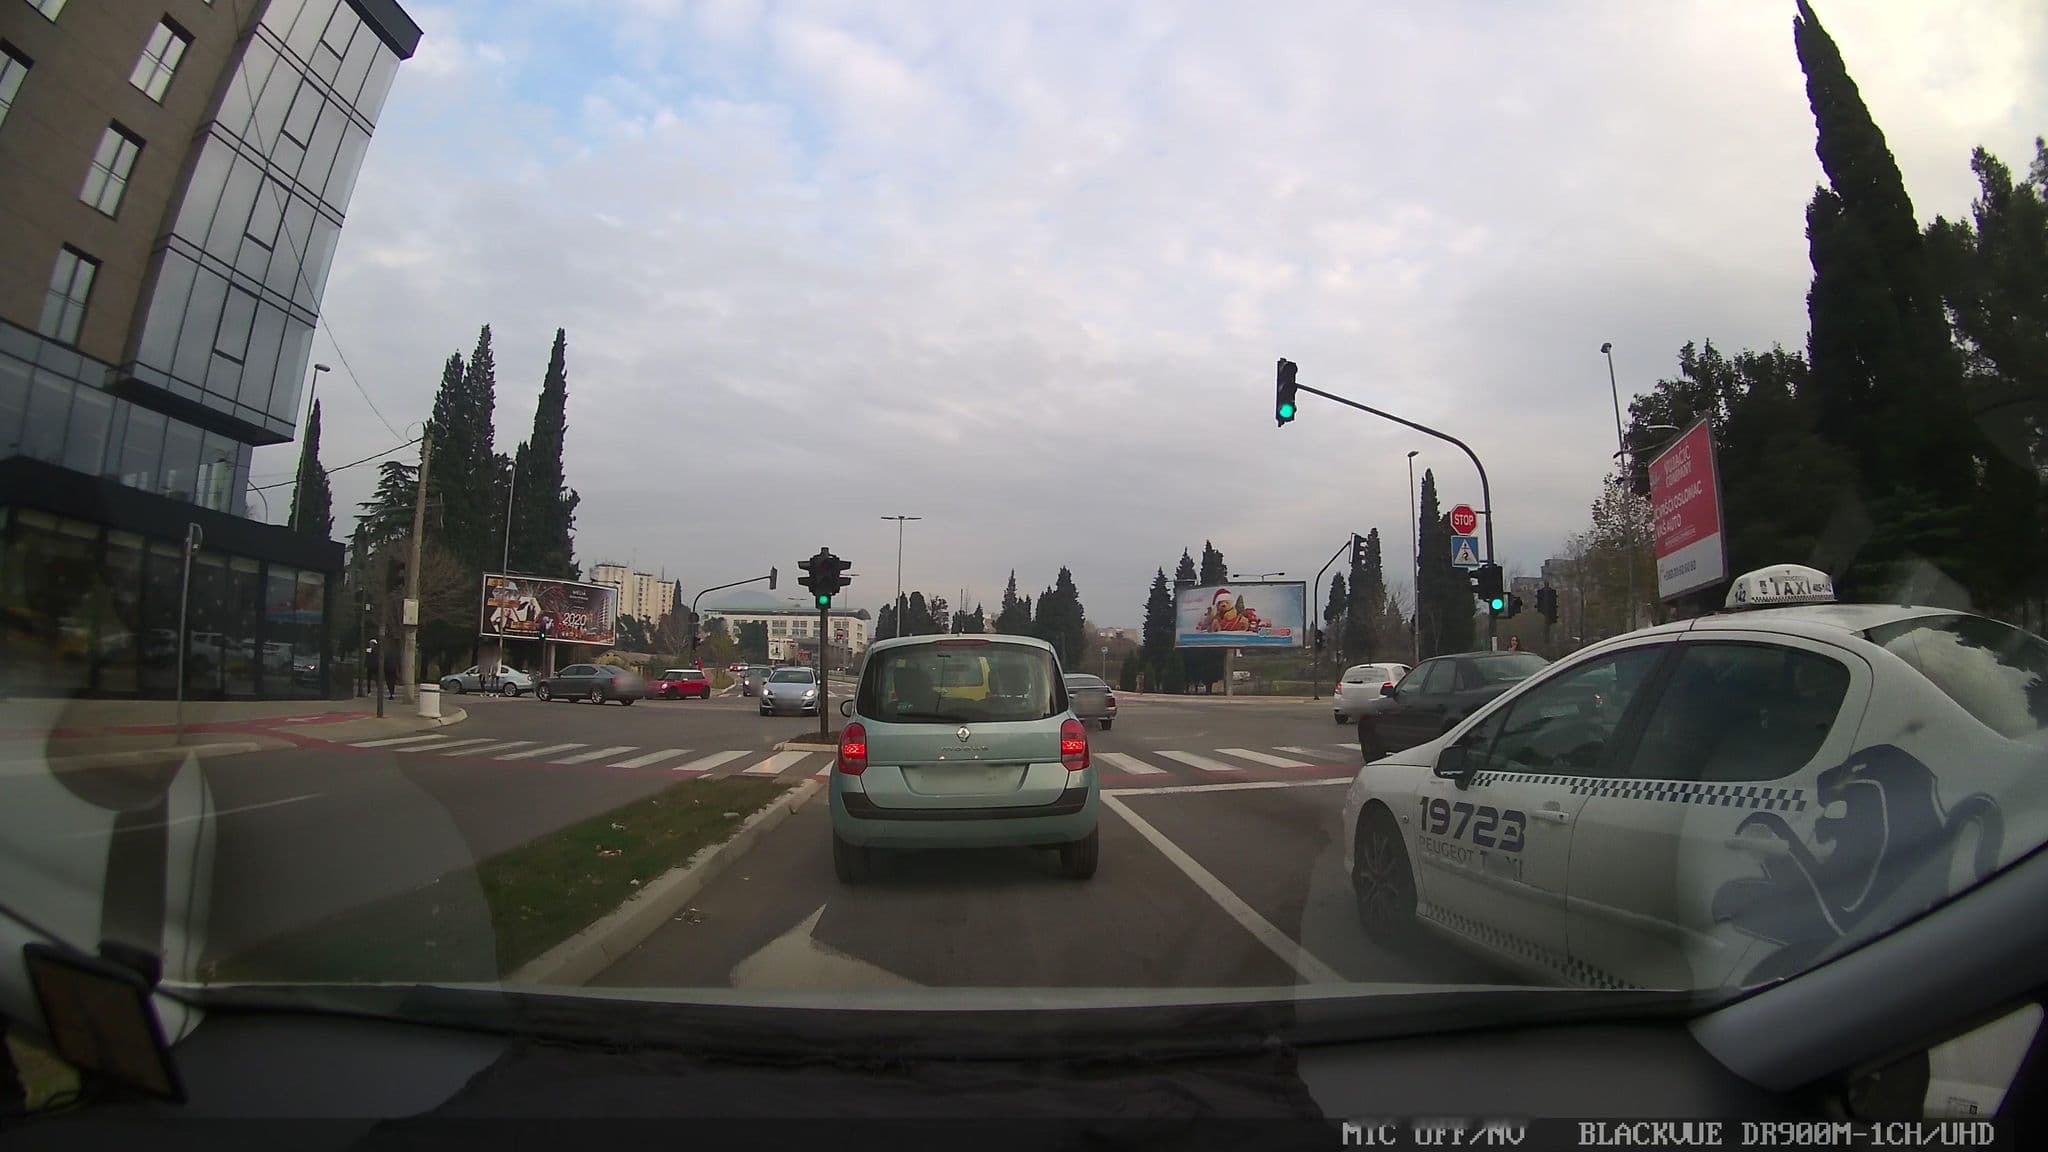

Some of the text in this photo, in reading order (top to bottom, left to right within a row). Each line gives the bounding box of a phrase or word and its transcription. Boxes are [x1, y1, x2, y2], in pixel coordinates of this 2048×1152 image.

[1454, 514, 1474, 526] STOP
[1769, 577, 1811, 595] TAXI
[562, 612, 587, 626] 2020
[1419, 796, 1526, 853] 19723
[1419, 835, 1474, 864] PEUGEOT
